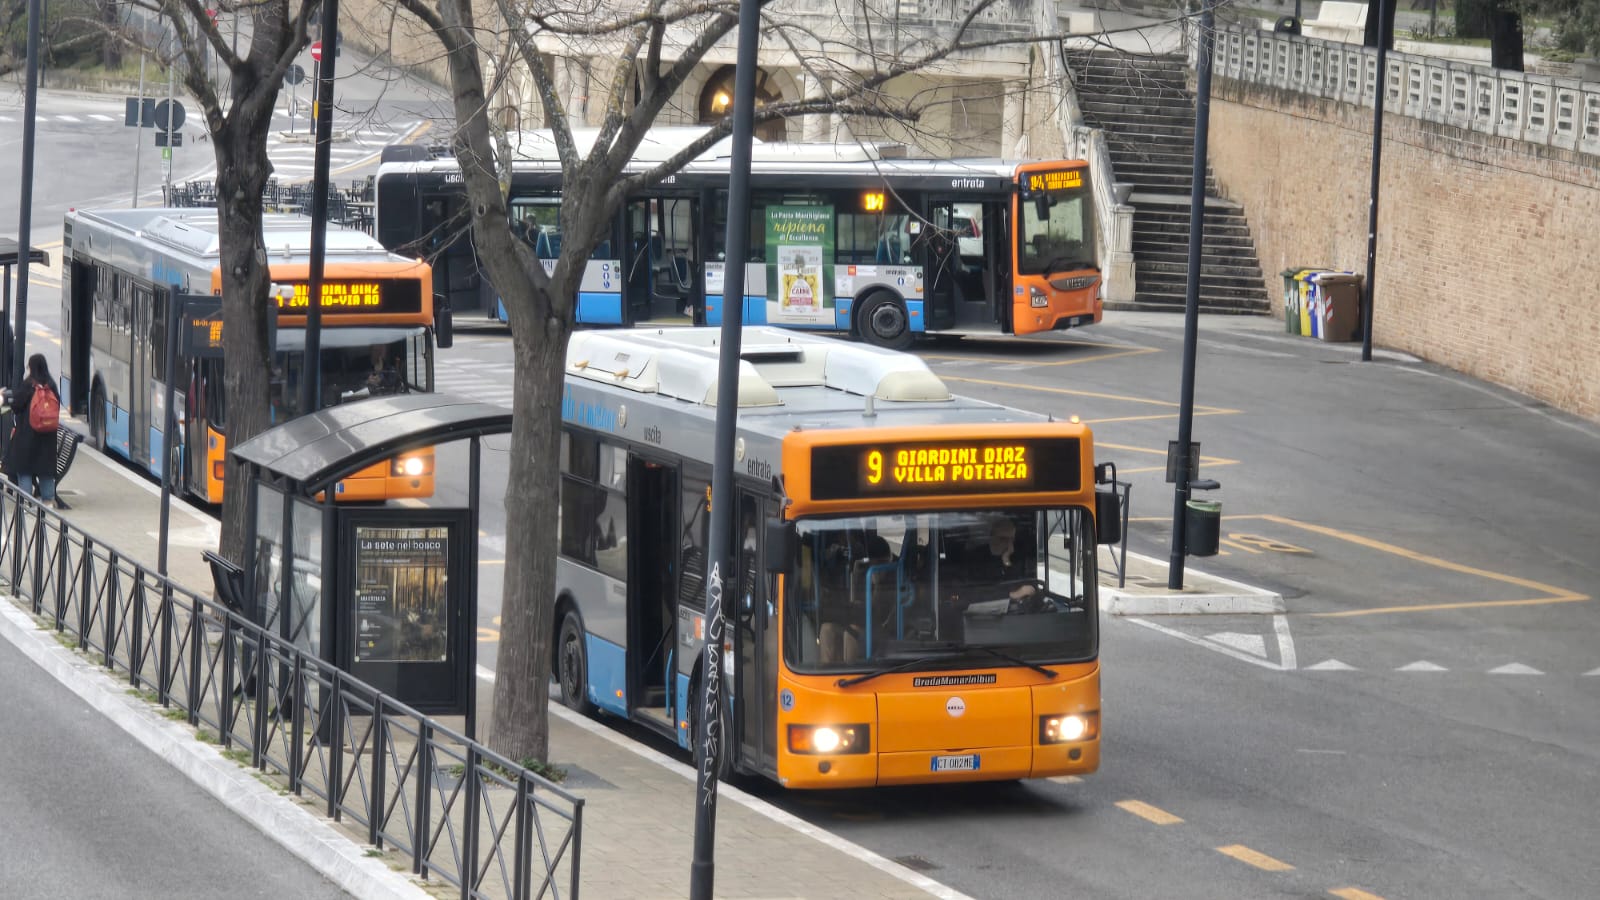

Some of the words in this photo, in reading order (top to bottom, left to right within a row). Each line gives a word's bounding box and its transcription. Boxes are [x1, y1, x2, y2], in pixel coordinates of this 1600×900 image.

[951, 178, 985, 189] entrata
[773, 218, 826, 244] ripiena
[643, 424, 662, 445] uscita
[747, 459, 772, 481] entrata
[867, 451, 882, 484] 9
[897, 448, 977, 466] GIARDINI
[984, 446, 1026, 464] DIAZ
[894, 465, 945, 483] VILLA
[952, 463, 1028, 481] POTENZA
[361, 539, 373, 550] La
[413, 539, 441, 550] bosco
[782, 694, 792, 706] 12
